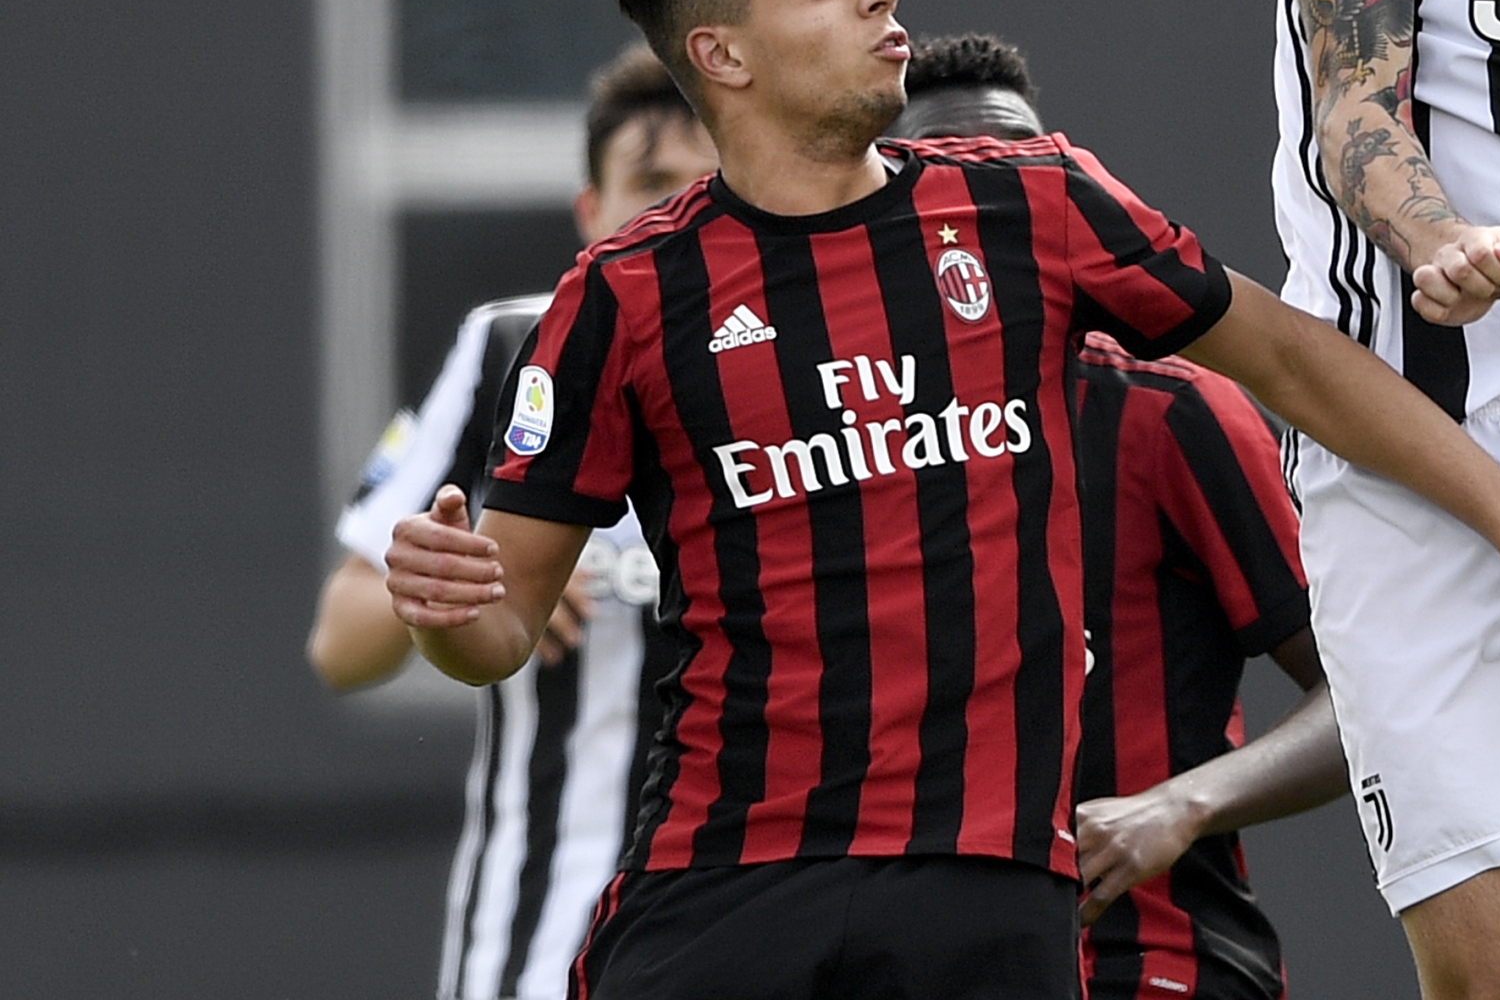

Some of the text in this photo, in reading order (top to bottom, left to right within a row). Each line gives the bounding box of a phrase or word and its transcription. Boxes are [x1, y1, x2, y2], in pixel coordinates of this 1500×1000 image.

[943, 251, 973, 267] ACM
[959, 303, 985, 315] 1899
[709, 326, 777, 353] adidas
[817, 355, 915, 408] Fly
[713, 400, 1031, 507] Emirates
